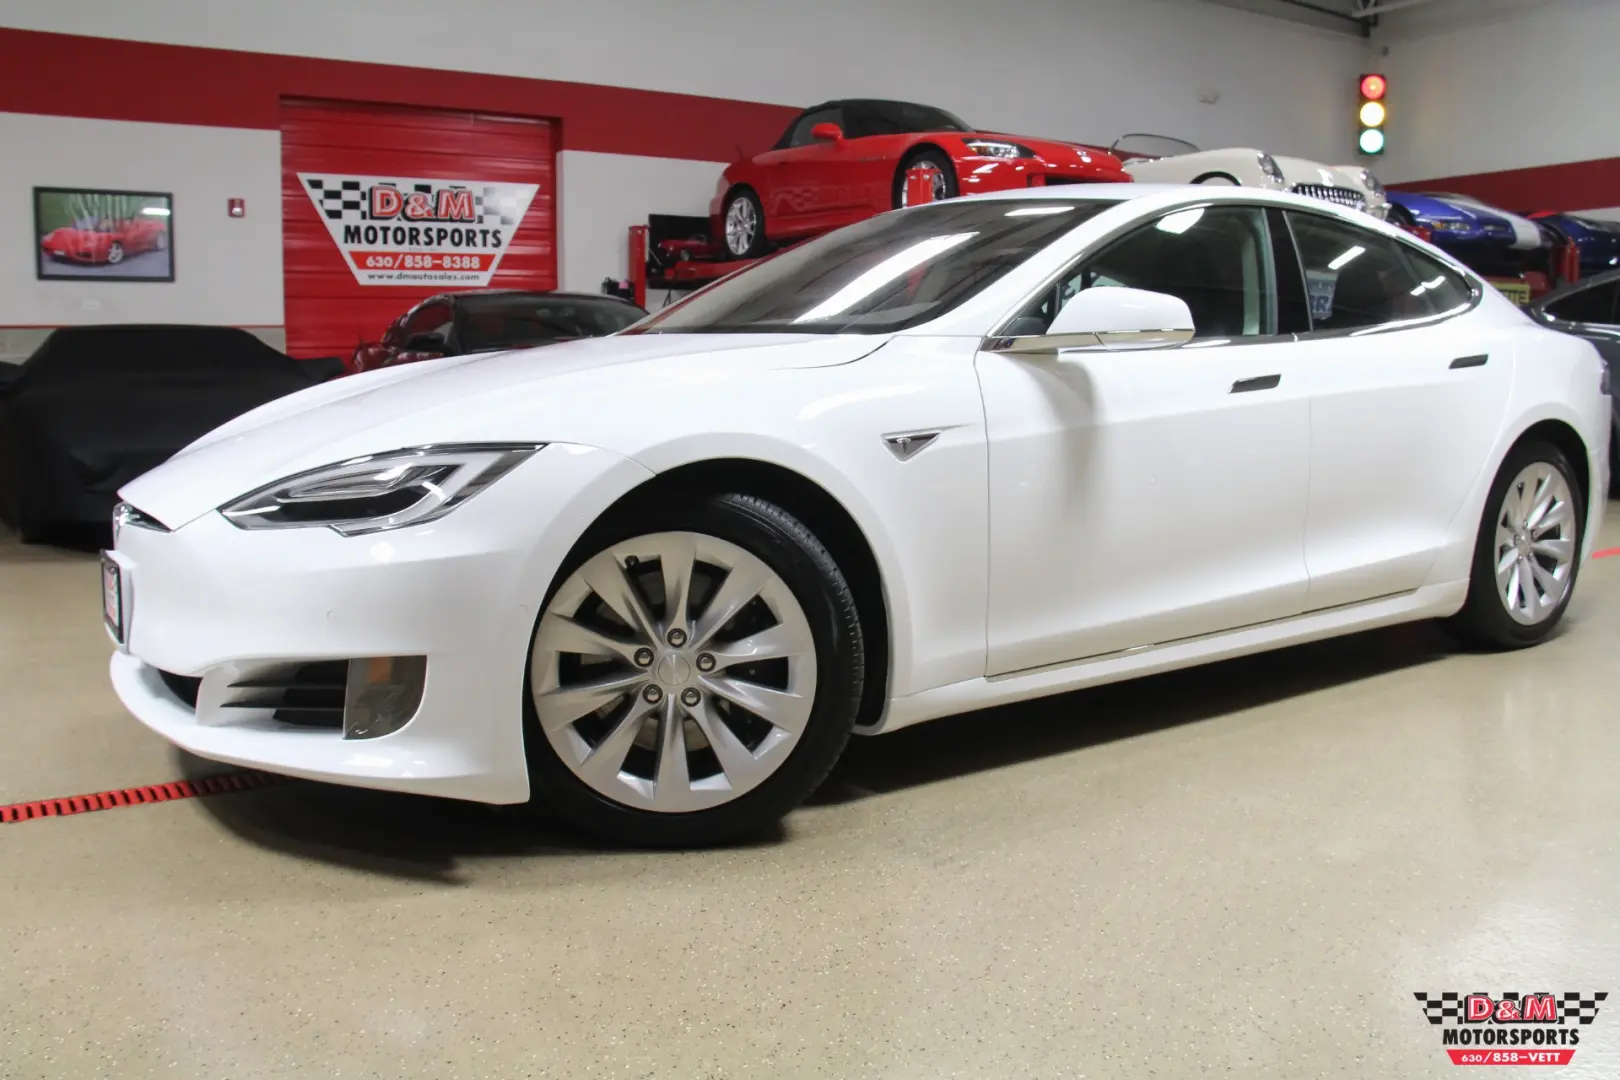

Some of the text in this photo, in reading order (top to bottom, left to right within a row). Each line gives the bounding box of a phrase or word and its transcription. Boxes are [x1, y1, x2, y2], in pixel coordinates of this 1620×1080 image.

[370, 186, 475, 222] D&M
[344, 225, 502, 248] MOTORSPORTS
[366, 255, 480, 269] 630/858-8388
[367, 272, 480, 281] www.dmautosales.com
